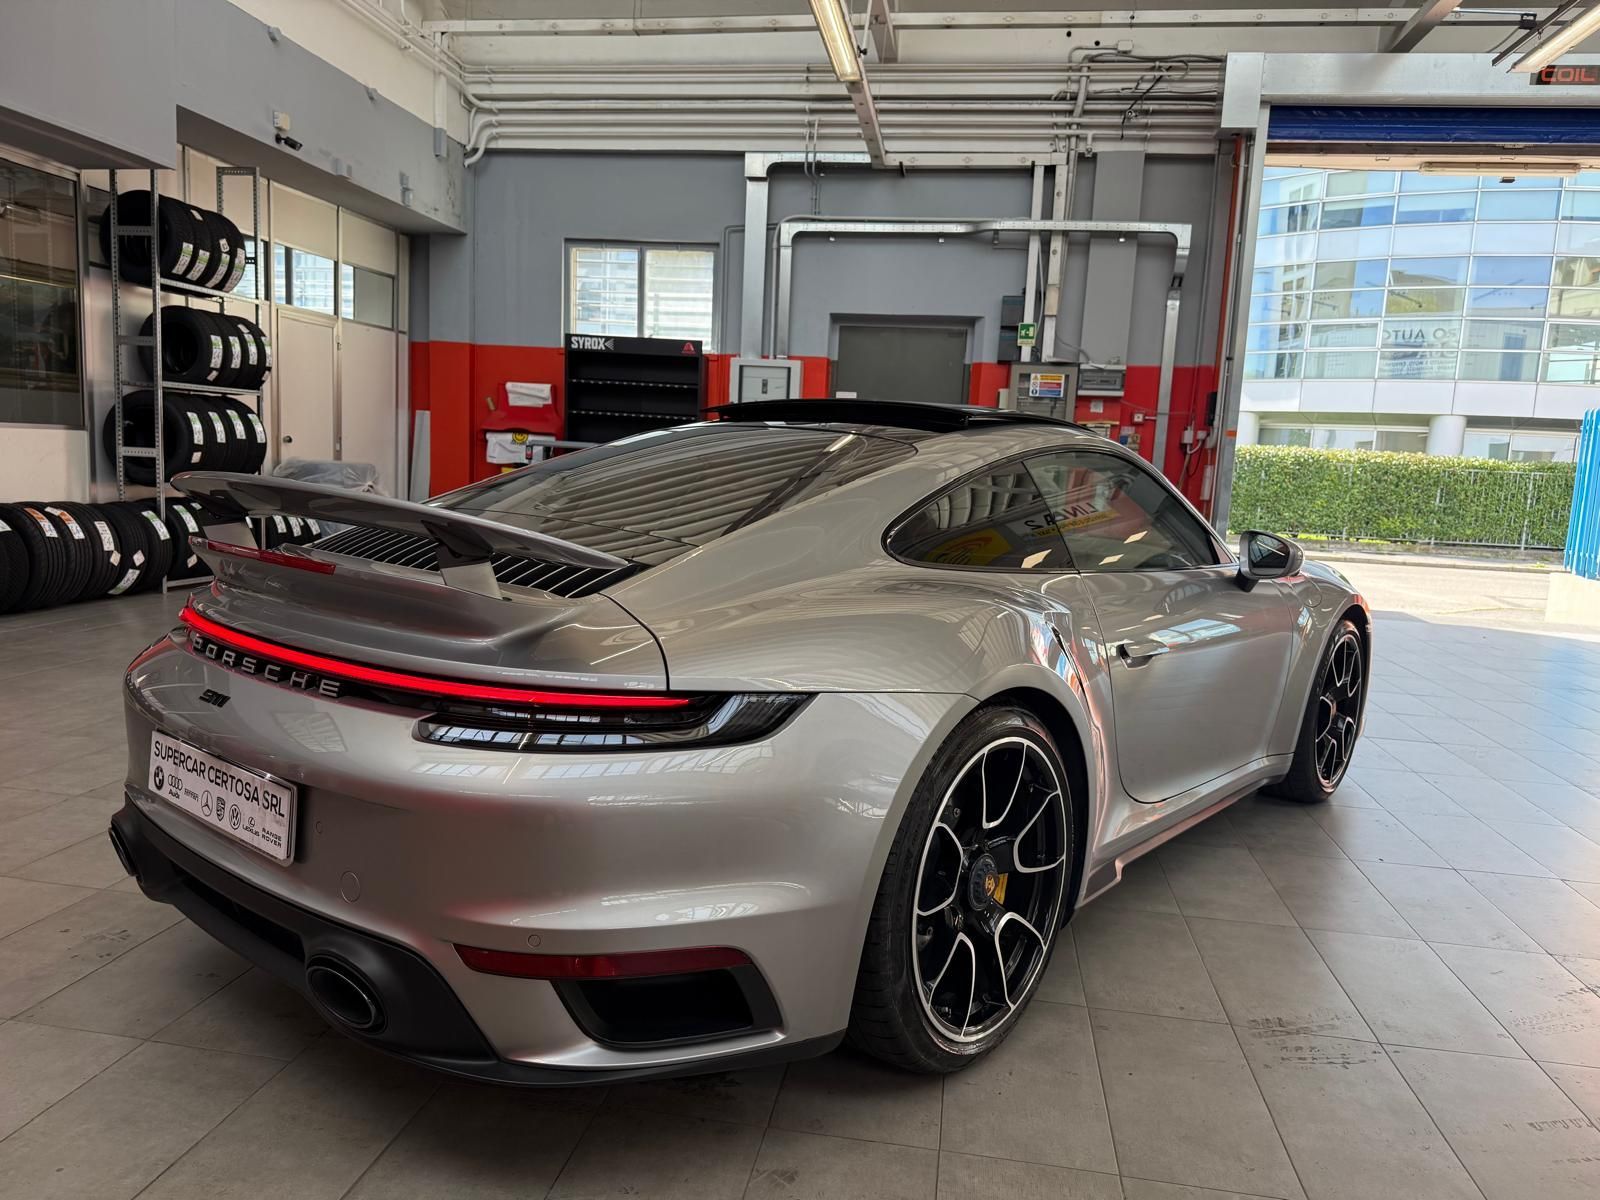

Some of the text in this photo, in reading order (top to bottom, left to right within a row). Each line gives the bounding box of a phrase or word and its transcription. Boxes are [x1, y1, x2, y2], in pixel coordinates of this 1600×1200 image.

[570, 336, 606, 350] SYROX
[192, 635, 341, 698] PORSCHE
[154, 740, 285, 818] SUPERCAR CERTOSA SRL
